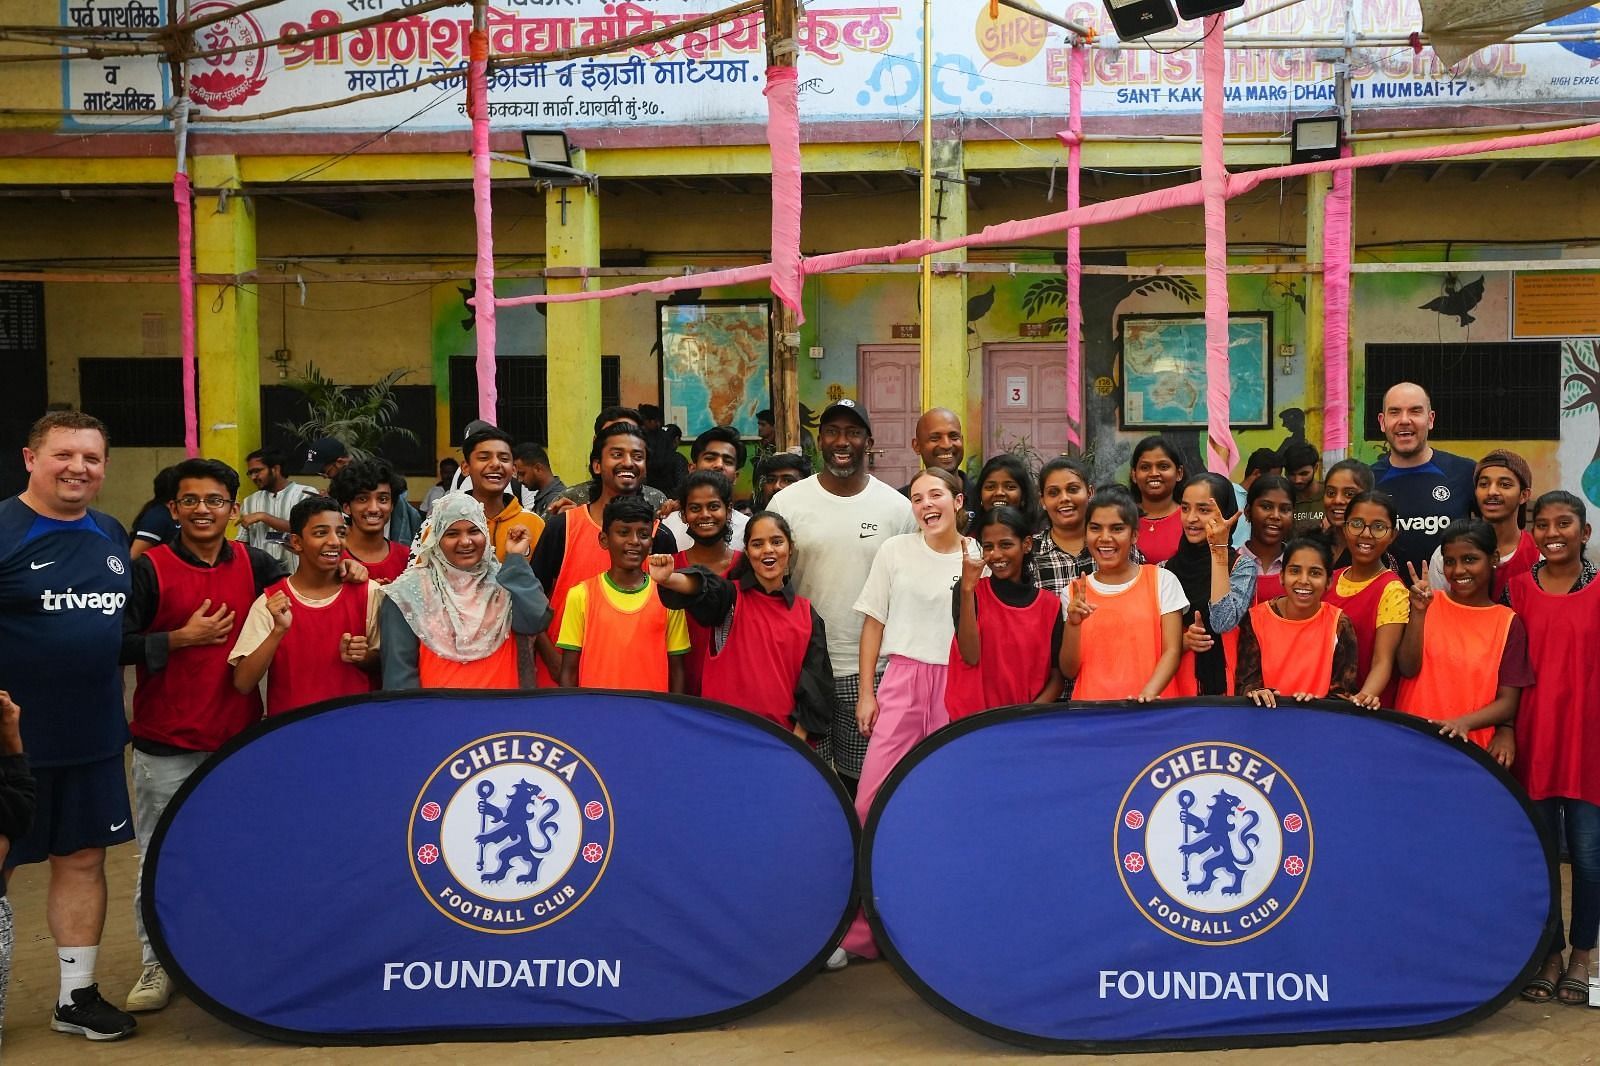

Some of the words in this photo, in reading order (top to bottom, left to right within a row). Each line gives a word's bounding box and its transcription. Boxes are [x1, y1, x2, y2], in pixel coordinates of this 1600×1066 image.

[97, 0, 160, 28] प्राथमिक
[277, 9, 342, 69] श्री
[348, 14, 475, 65] गणेश
[103, 65, 121, 85] व
[345, 63, 409, 92] मराठी
[581, 55, 647, 92] इंग्रजी
[1550, 76, 1571, 86] HIGH
[83, 87, 156, 111] माध्यमिक
[1117, 86, 1162, 104] SANT
[1246, 85, 1288, 102] MARG
[1295, 83, 1364, 101] DHARVI
[1012, 388, 1021, 401] 3
[861, 522, 878, 531] CFC
[1395, 514, 1451, 535] ivago
[41, 587, 126, 615] trivago
[449, 739, 580, 783] CHELSEA
[1150, 749, 1278, 794] CHELSEA
[439, 886, 526, 923] FOOTBALL
[533, 885, 576, 917] CLUB
[1148, 896, 1232, 935] FOOTBALL
[1239, 897, 1280, 929] CLUB
[383, 958, 621, 991] FOUNDATION
[1099, 970, 1329, 1002] FOUNDATION
